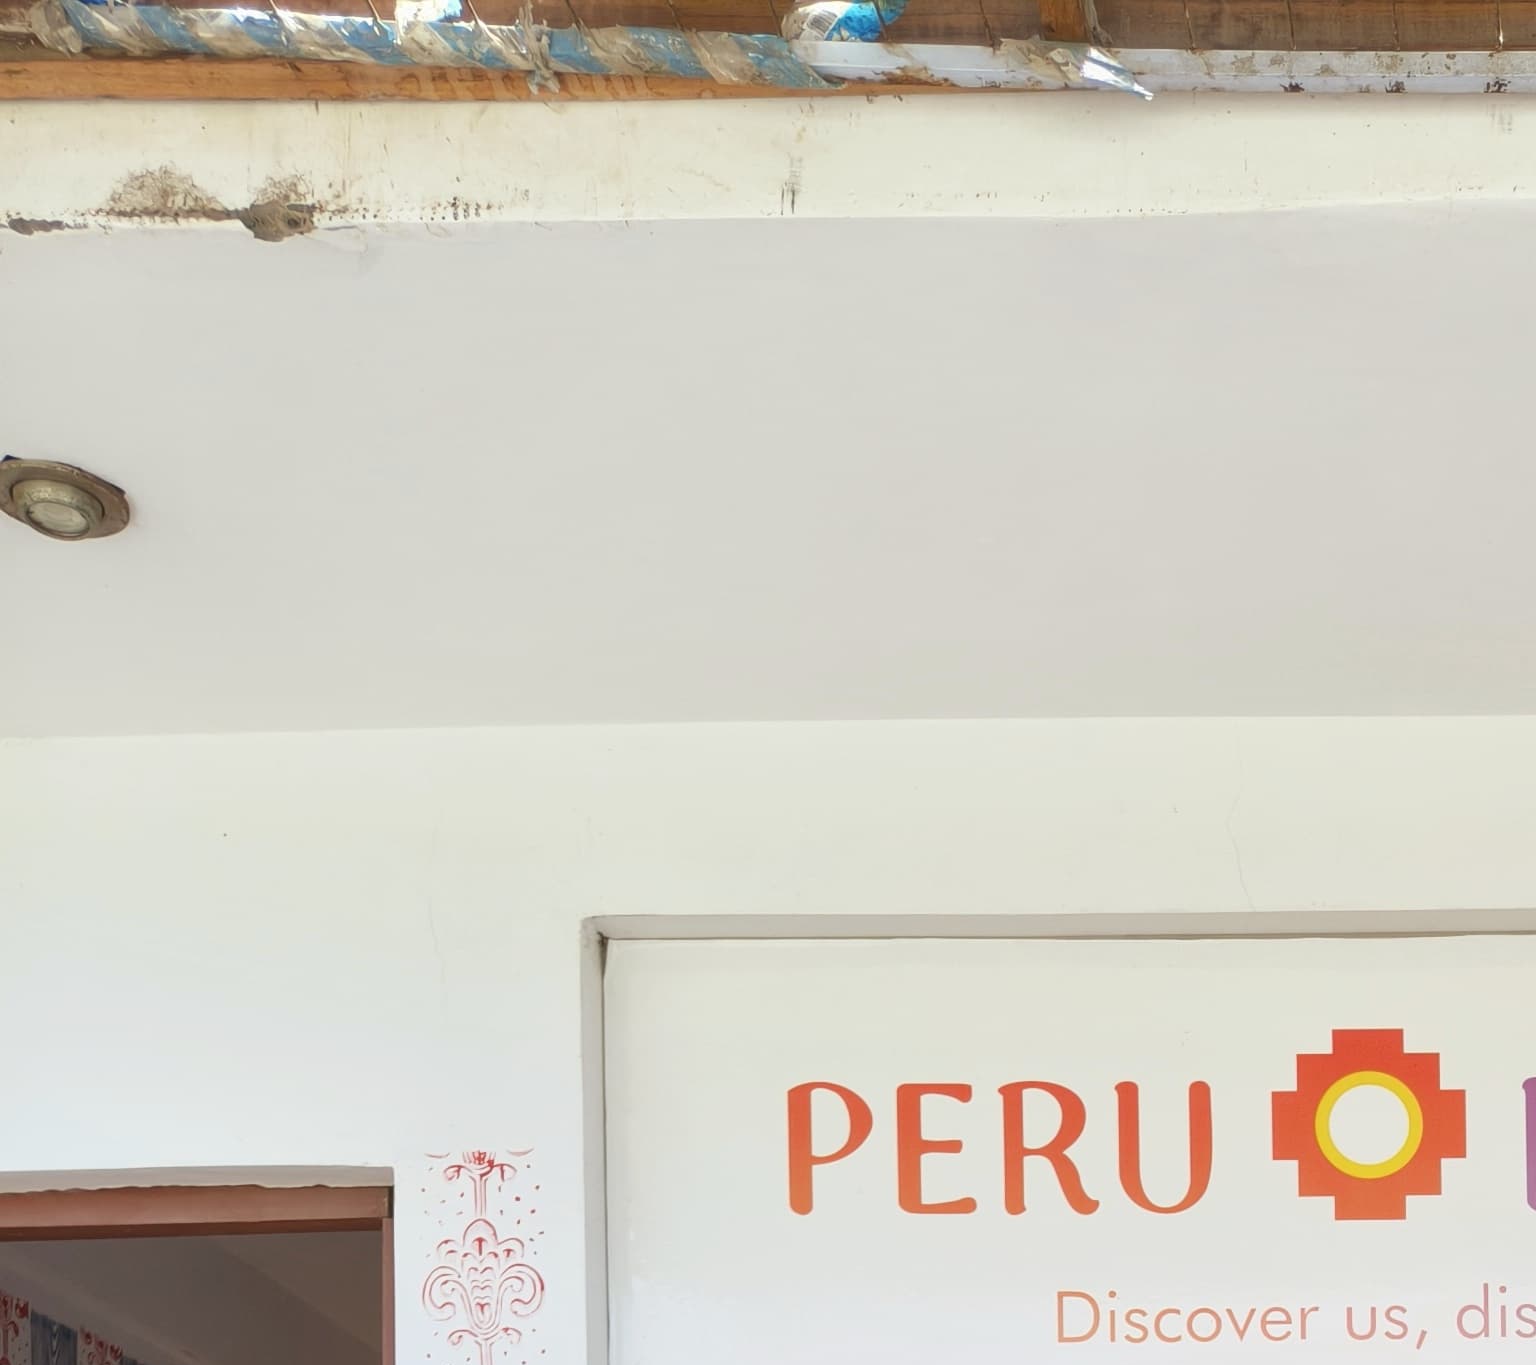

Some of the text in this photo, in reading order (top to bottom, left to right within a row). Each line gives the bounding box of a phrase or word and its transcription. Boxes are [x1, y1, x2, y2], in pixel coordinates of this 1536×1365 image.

[785, 1079, 1214, 1217] PERU
[1055, 1288, 1320, 1345] Discover
[1345, 1304, 1428, 1350] us,
